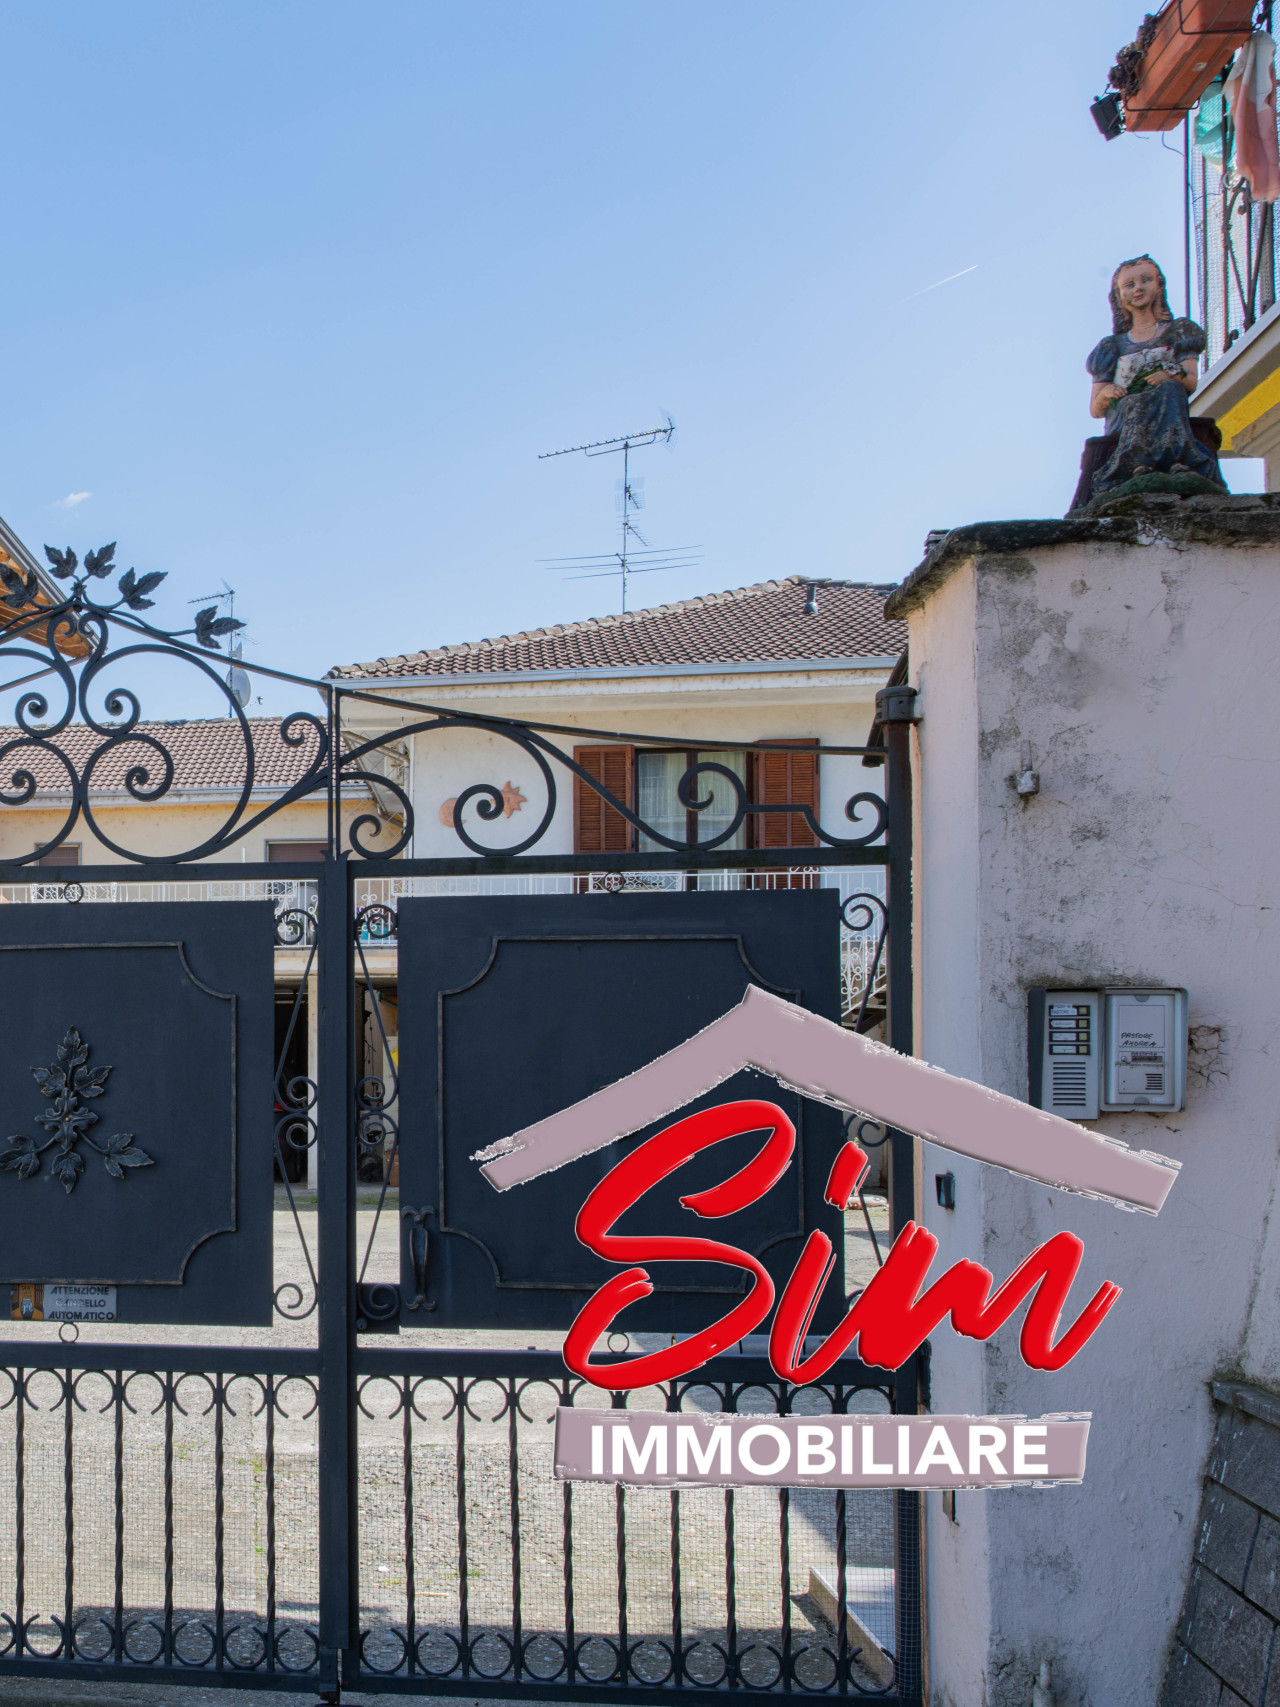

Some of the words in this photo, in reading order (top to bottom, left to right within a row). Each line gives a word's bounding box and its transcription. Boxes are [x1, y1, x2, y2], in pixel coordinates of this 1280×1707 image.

[1121, 1032, 1154, 1040] PASTORE
[50, 1286, 109, 1296] ATTENZIONE
[48, 1311, 115, 1320] AUTOMATICO
